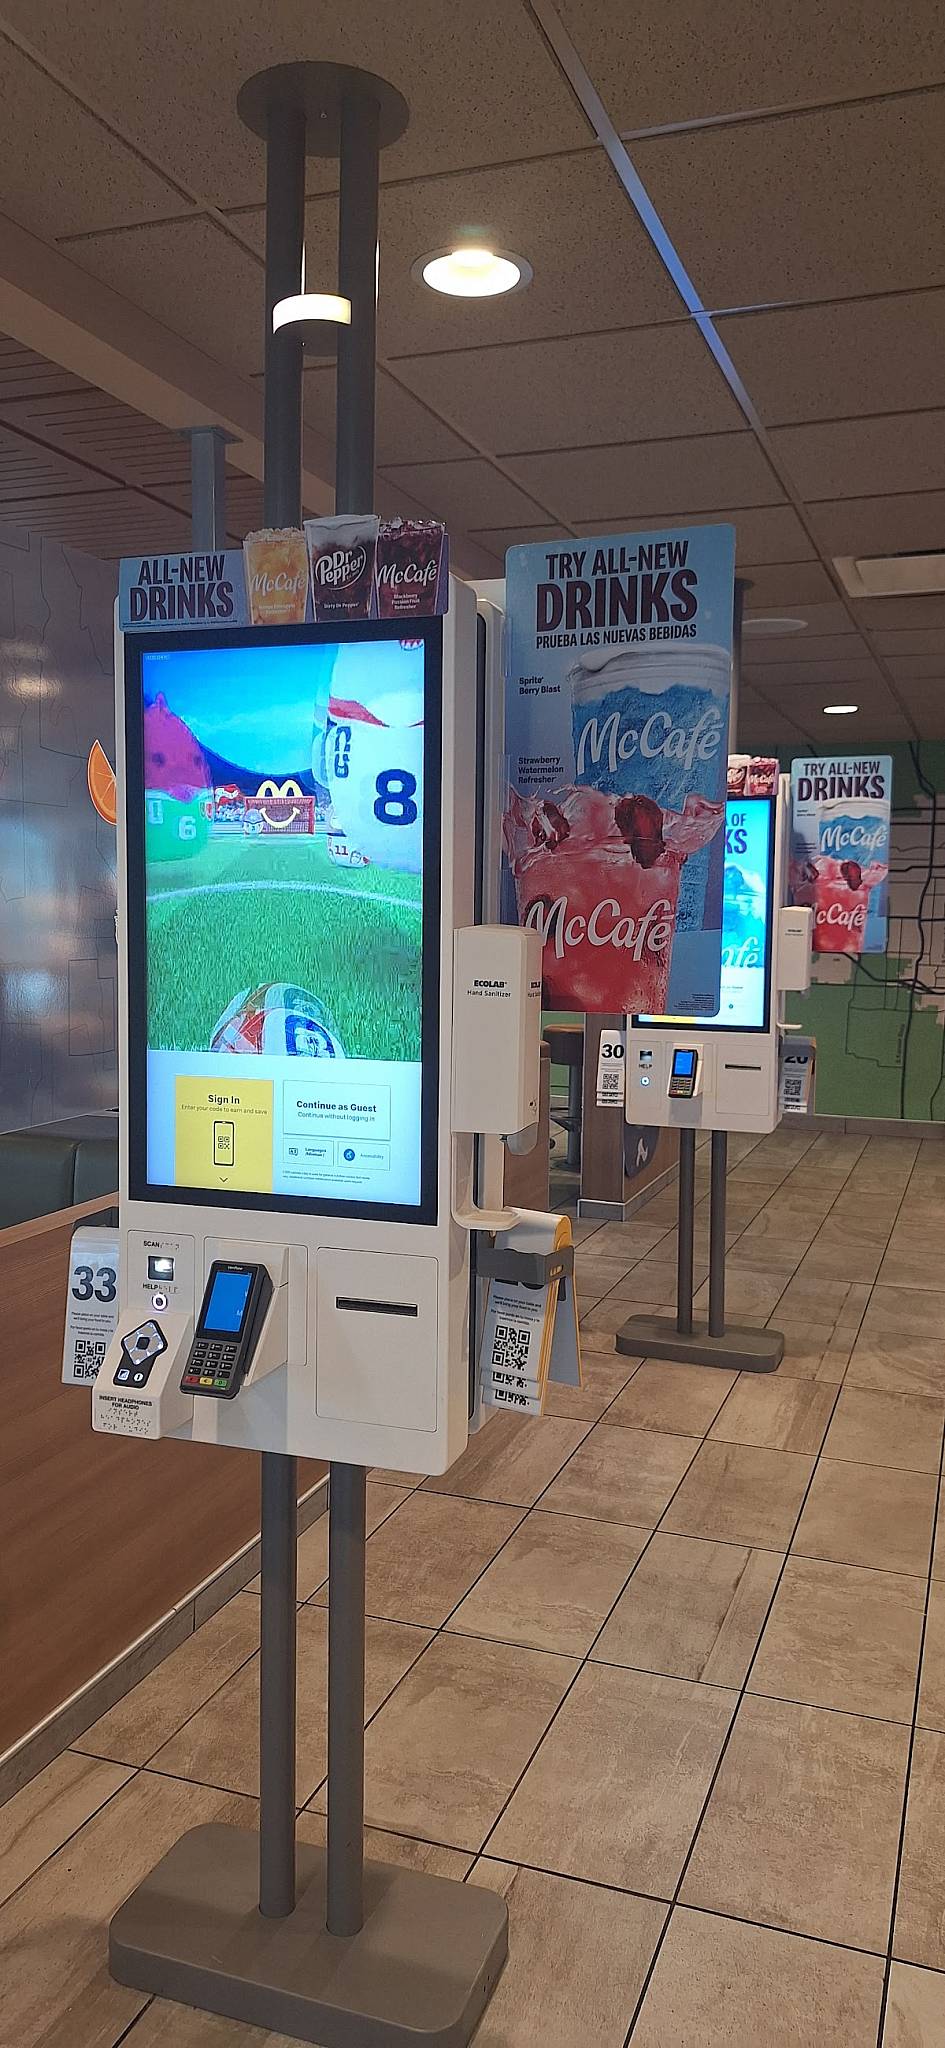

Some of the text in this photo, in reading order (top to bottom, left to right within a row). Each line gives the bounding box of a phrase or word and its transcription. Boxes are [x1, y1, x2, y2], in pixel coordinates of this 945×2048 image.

[332, 550, 353, 568] Dr
[545, 540, 689, 580] TRY ALL-NEW
[137, 554, 226, 586] ALL-NEW
[318, 554, 364, 586] Pepper
[377, 559, 438, 589] McCafé
[251, 568, 306, 597] McCafé
[130, 581, 234, 622] DRINKS
[536, 568, 699, 633] DRINKS
[536, 624, 697, 649] PRUEBA LAS NUEVAS BEBIDAS
[519, 676, 543, 687] Sprite
[519, 685, 561, 696] Berry Blast
[577, 705, 724, 776] McCafé
[518, 756, 561, 766] Strawberry
[803, 761, 881, 776] TRY ALL-NEW
[518, 766, 564, 775] Watermelon
[518, 776, 556, 785] Refresher
[797, 775, 885, 801] DRINKS
[373, 768, 418, 826] 8
[731, 812, 747, 826] OF
[821, 823, 888, 854] McCafé
[525, 895, 675, 962] McCafé
[473, 979, 505, 988] ECOLAB
[484, 990, 511, 998] Sanitizer
[601, 1044, 625, 1058] 30
[207, 1094, 240, 1105] Sign In
[296, 1100, 337, 1110] Continue
[350, 1103, 377, 1113] Guest
[297, 1111, 324, 1119] Continue
[346, 1114, 369, 1122] logging
[143, 1240, 160, 1248] SCAN
[71, 1265, 117, 1303] 33
